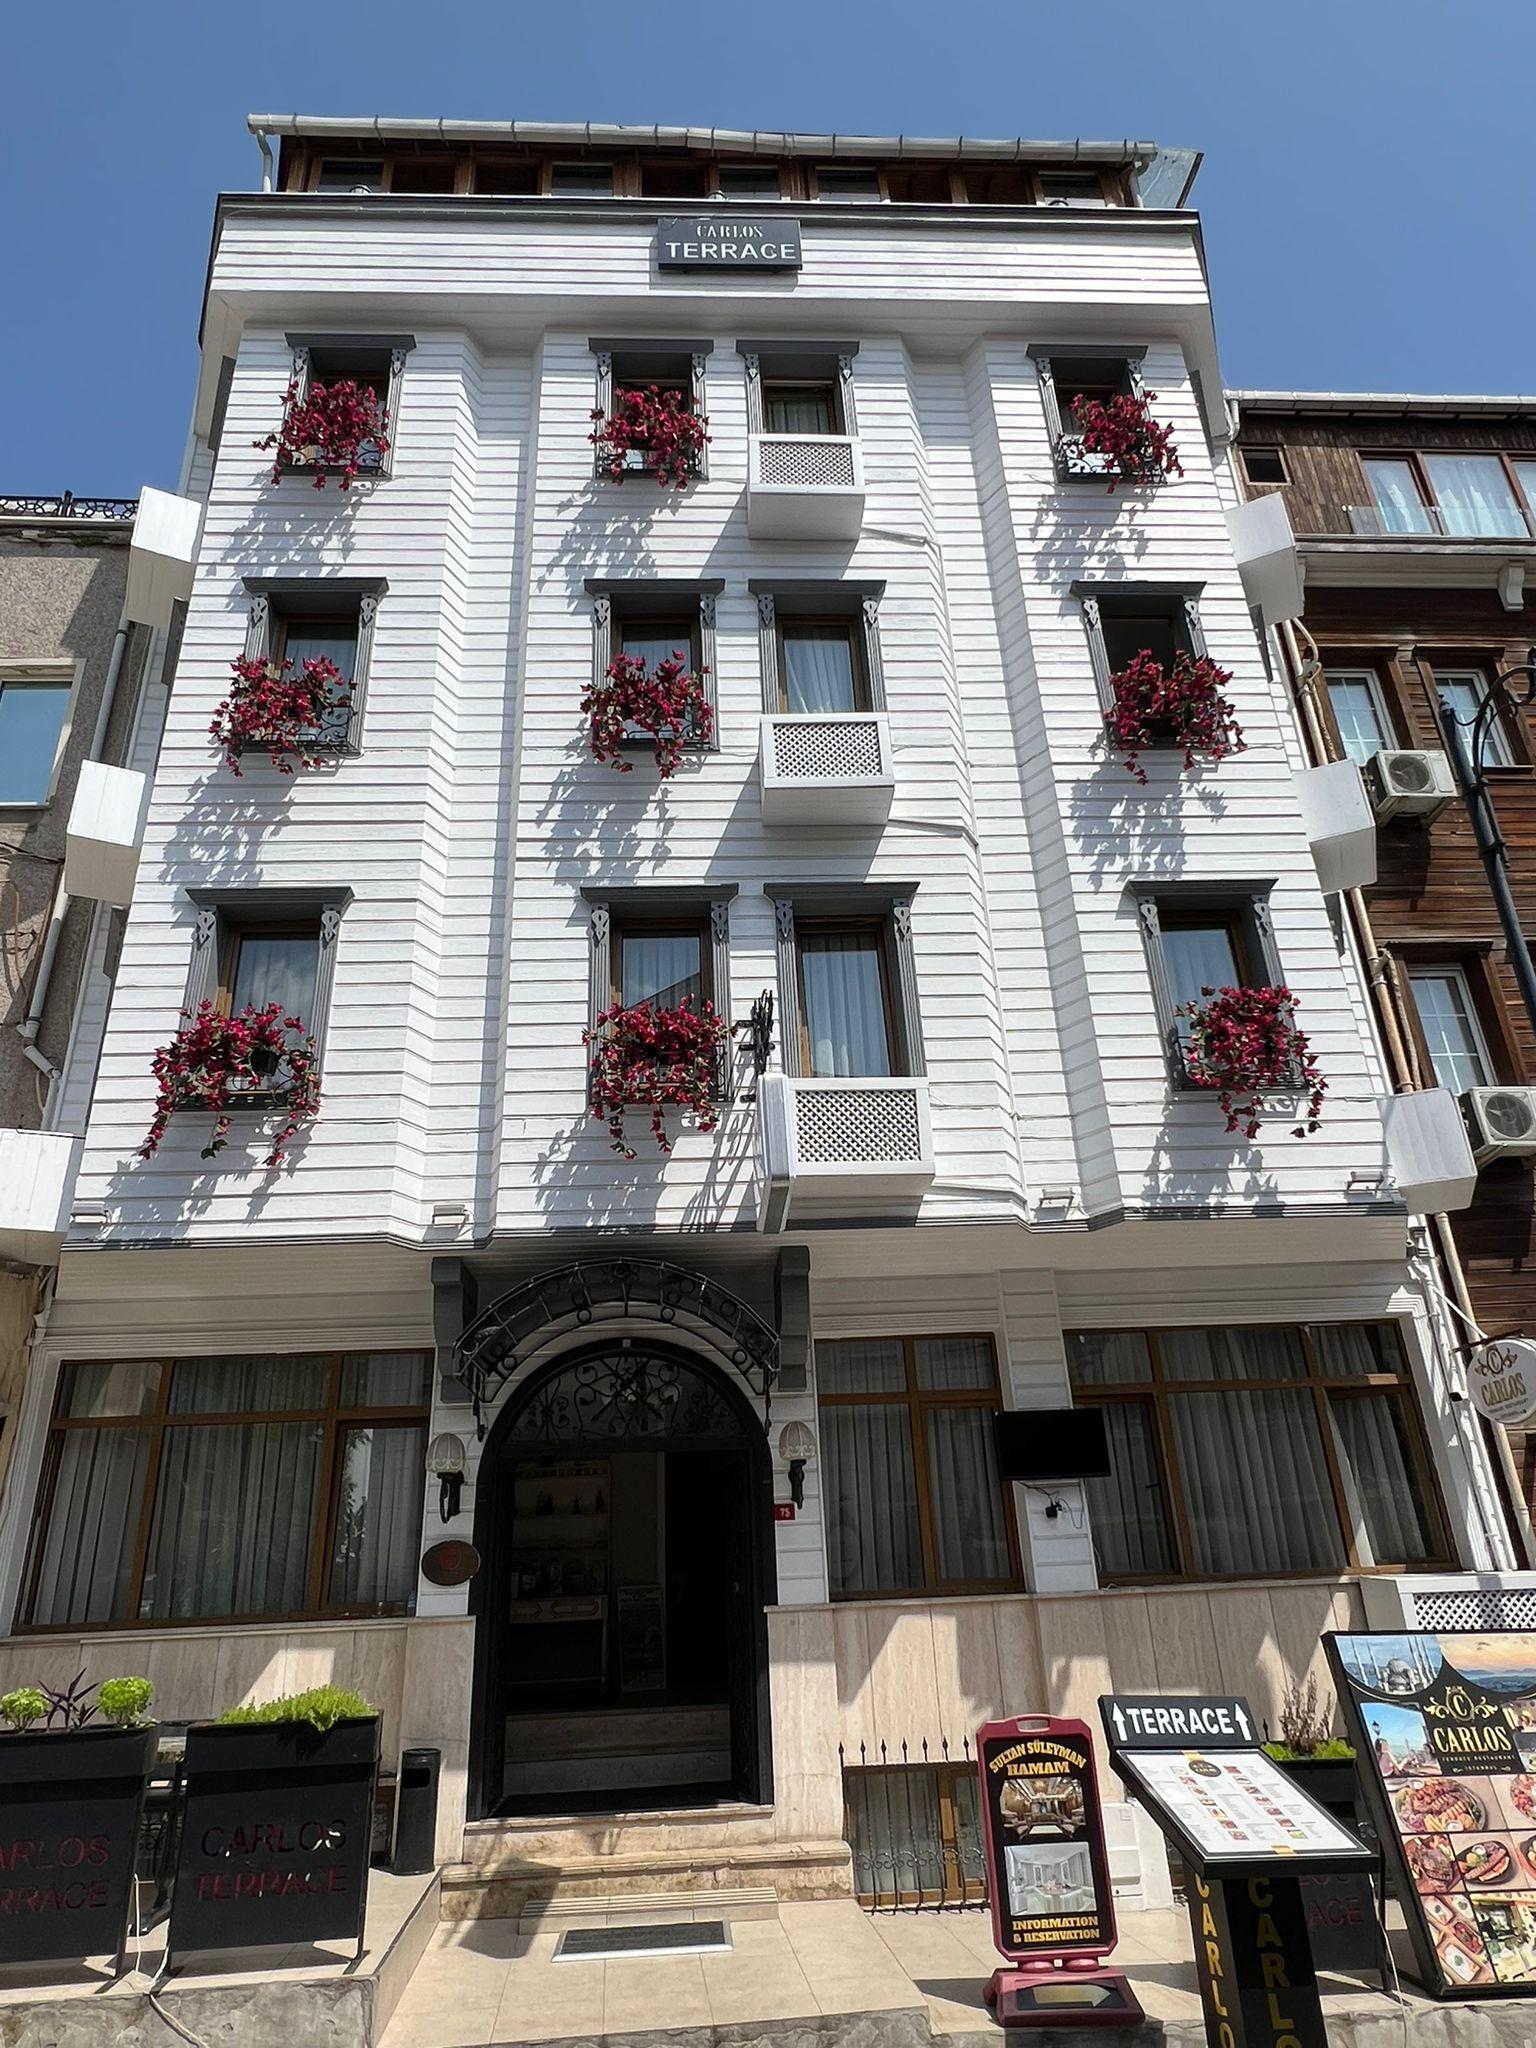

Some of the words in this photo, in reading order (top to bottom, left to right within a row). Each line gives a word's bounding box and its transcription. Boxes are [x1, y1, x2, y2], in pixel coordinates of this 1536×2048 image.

[696, 225, 763, 238] CARLOS
[665, 242, 797, 259] TERRACE
[1480, 1372, 1527, 1407] CARLOS
[1127, 1703, 1235, 1736] TERRACE
[1433, 1726, 1512, 1753] CARLOS
[989, 1743, 1027, 1773] SULTAN
[1026, 1739, 1087, 1768] SÜLEYMAN
[1006, 1761, 1071, 1776] HAMAM
[202, 1819, 346, 1857] CARLOS
[195, 1864, 347, 1902] TERRACE
[1012, 1916, 1099, 1930] INFORMATION
[1013, 1933, 1022, 1943] &
[1023, 1929, 1100, 1943] RESERVATION
